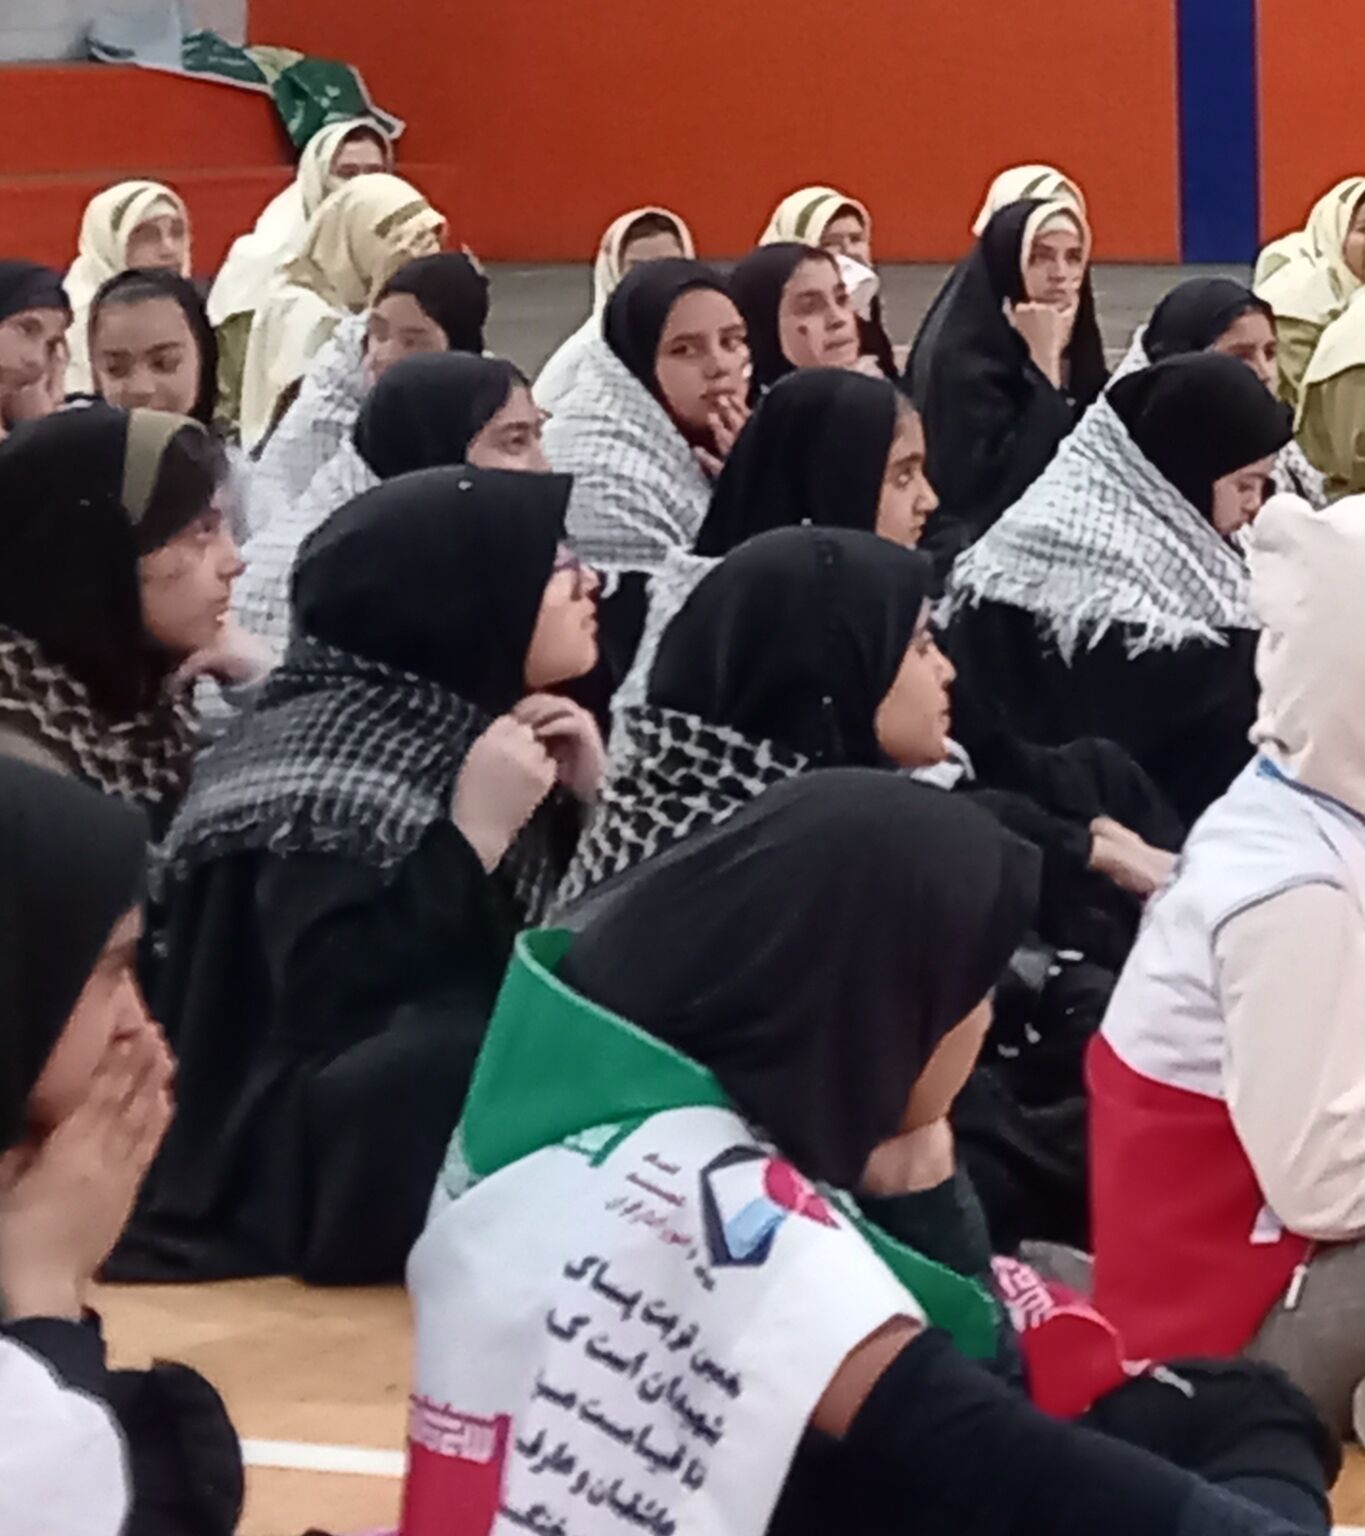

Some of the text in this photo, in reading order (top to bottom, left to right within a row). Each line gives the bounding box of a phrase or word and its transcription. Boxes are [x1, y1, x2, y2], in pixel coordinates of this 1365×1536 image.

[586, 1333, 648, 1378] است
[579, 1399, 687, 1474] قیامت
[637, 1373, 725, 1447] شهیدان
